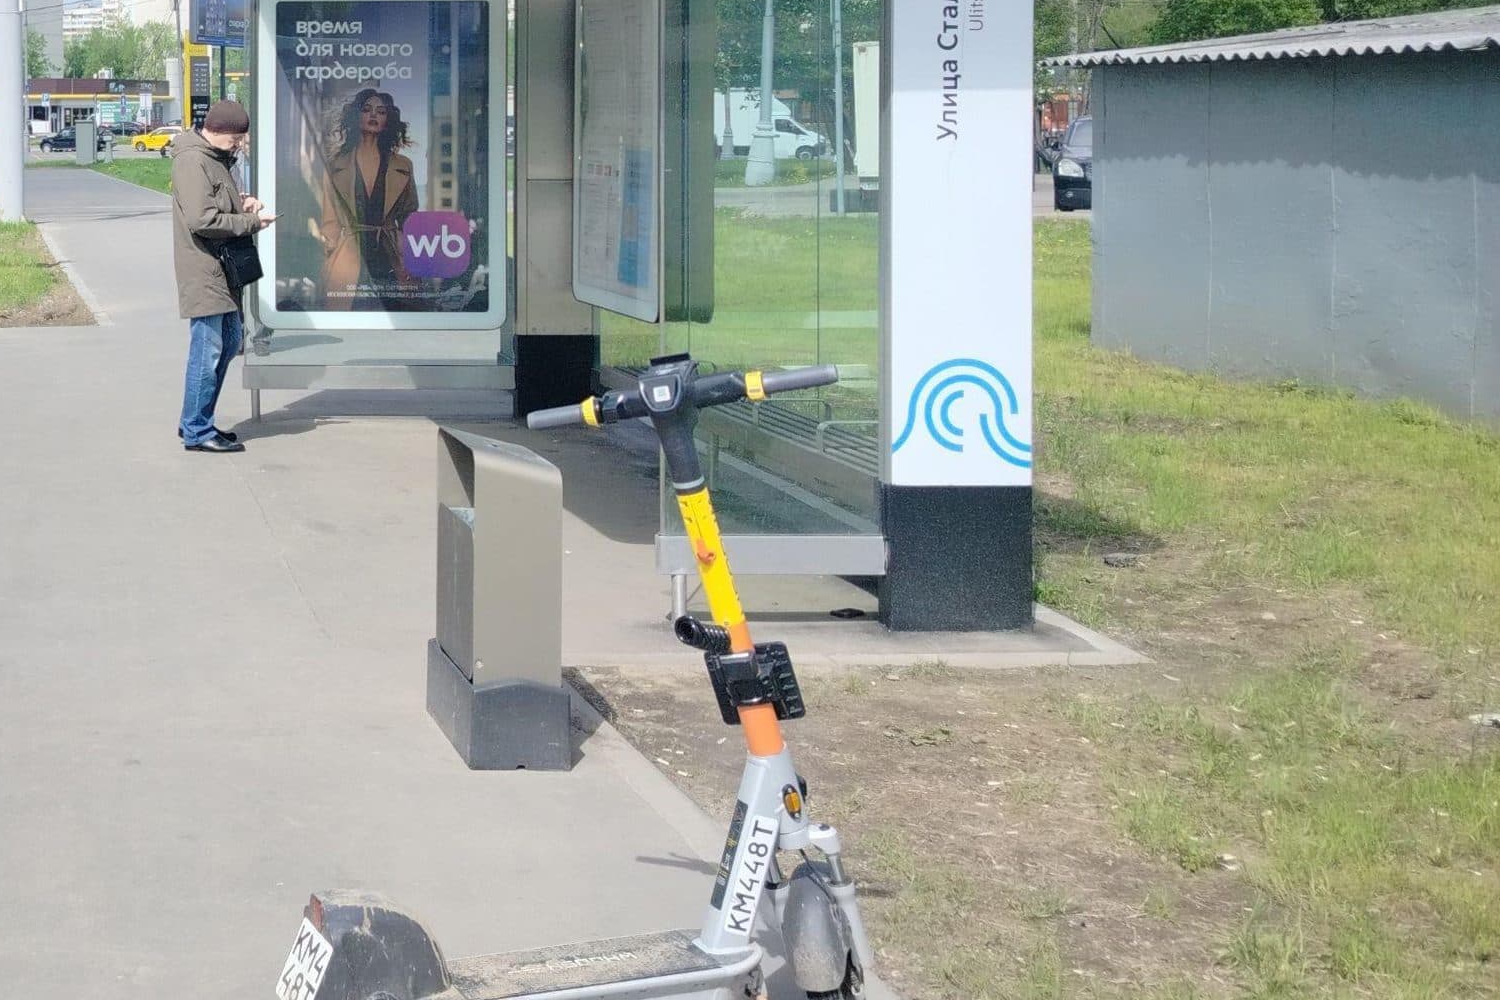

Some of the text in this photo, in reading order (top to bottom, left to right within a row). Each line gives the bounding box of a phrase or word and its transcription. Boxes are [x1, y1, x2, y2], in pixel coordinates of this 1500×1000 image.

[295, 19, 363, 38] время
[295, 39, 413, 58] для нового
[295, 62, 413, 82] гардероба
[937, 58, 961, 140] Улица
[407, 224, 466, 259] wb
